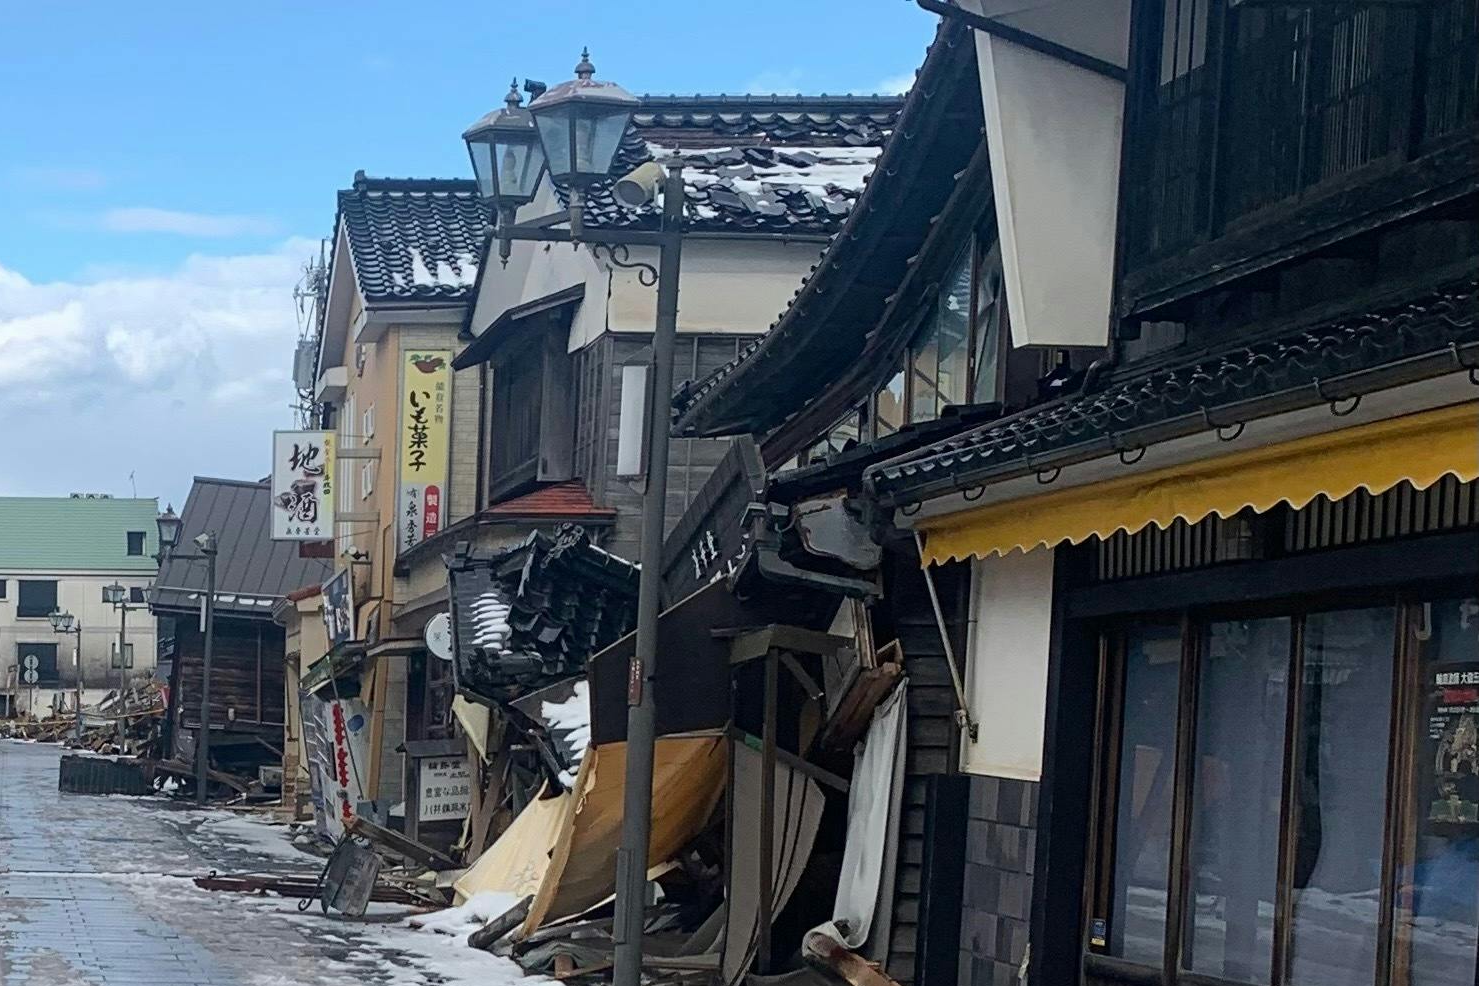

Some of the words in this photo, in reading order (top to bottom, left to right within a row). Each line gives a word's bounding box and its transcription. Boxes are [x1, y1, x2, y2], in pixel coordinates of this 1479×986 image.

[408, 390, 431, 472] いも菓子
[288, 442, 325, 524] 地酒
